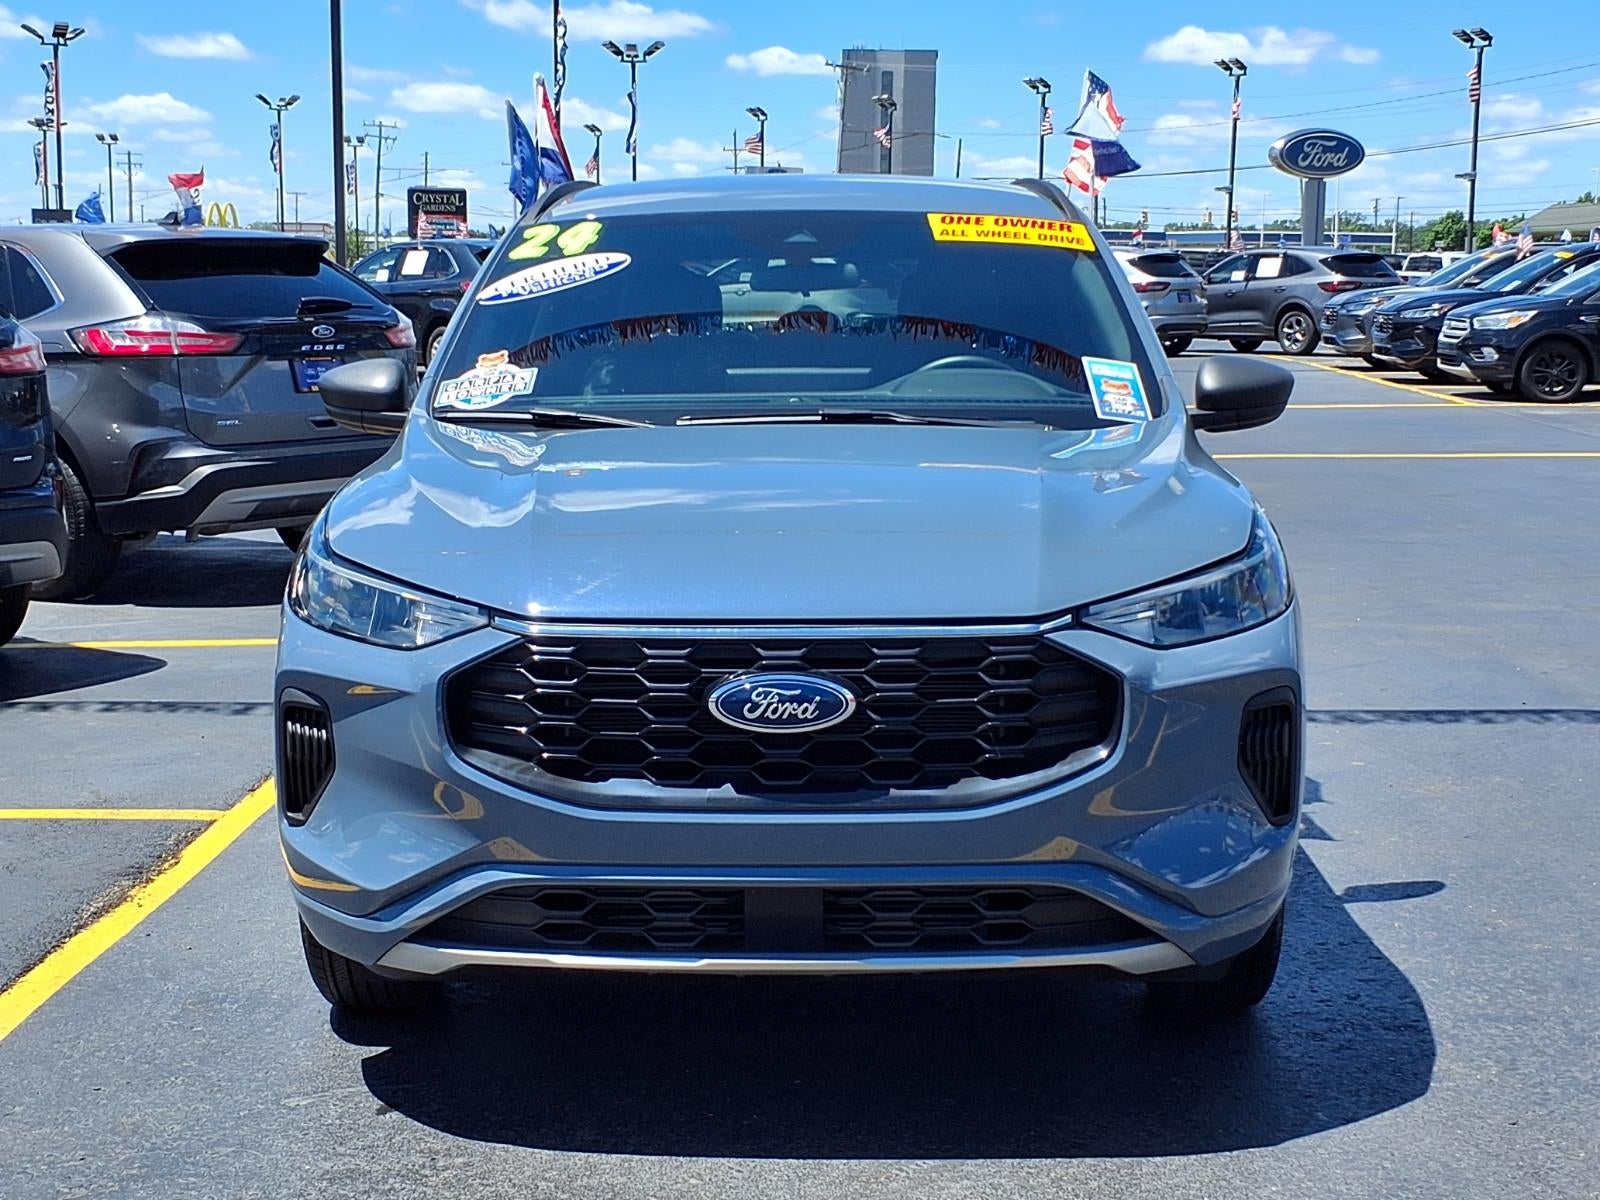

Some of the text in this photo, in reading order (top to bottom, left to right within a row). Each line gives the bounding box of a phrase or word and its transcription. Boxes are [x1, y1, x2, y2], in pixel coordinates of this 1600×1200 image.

[1298, 139, 1349, 168] Ford
[413, 192, 464, 206] CRYSTAL
[420, 204, 456, 212] GARDENS
[940, 215, 1073, 233] ONE OWNER
[508, 221, 603, 260] 24
[939, 228, 1086, 246] ALL WHEEL DRIVE
[743, 686, 821, 720] Ford
